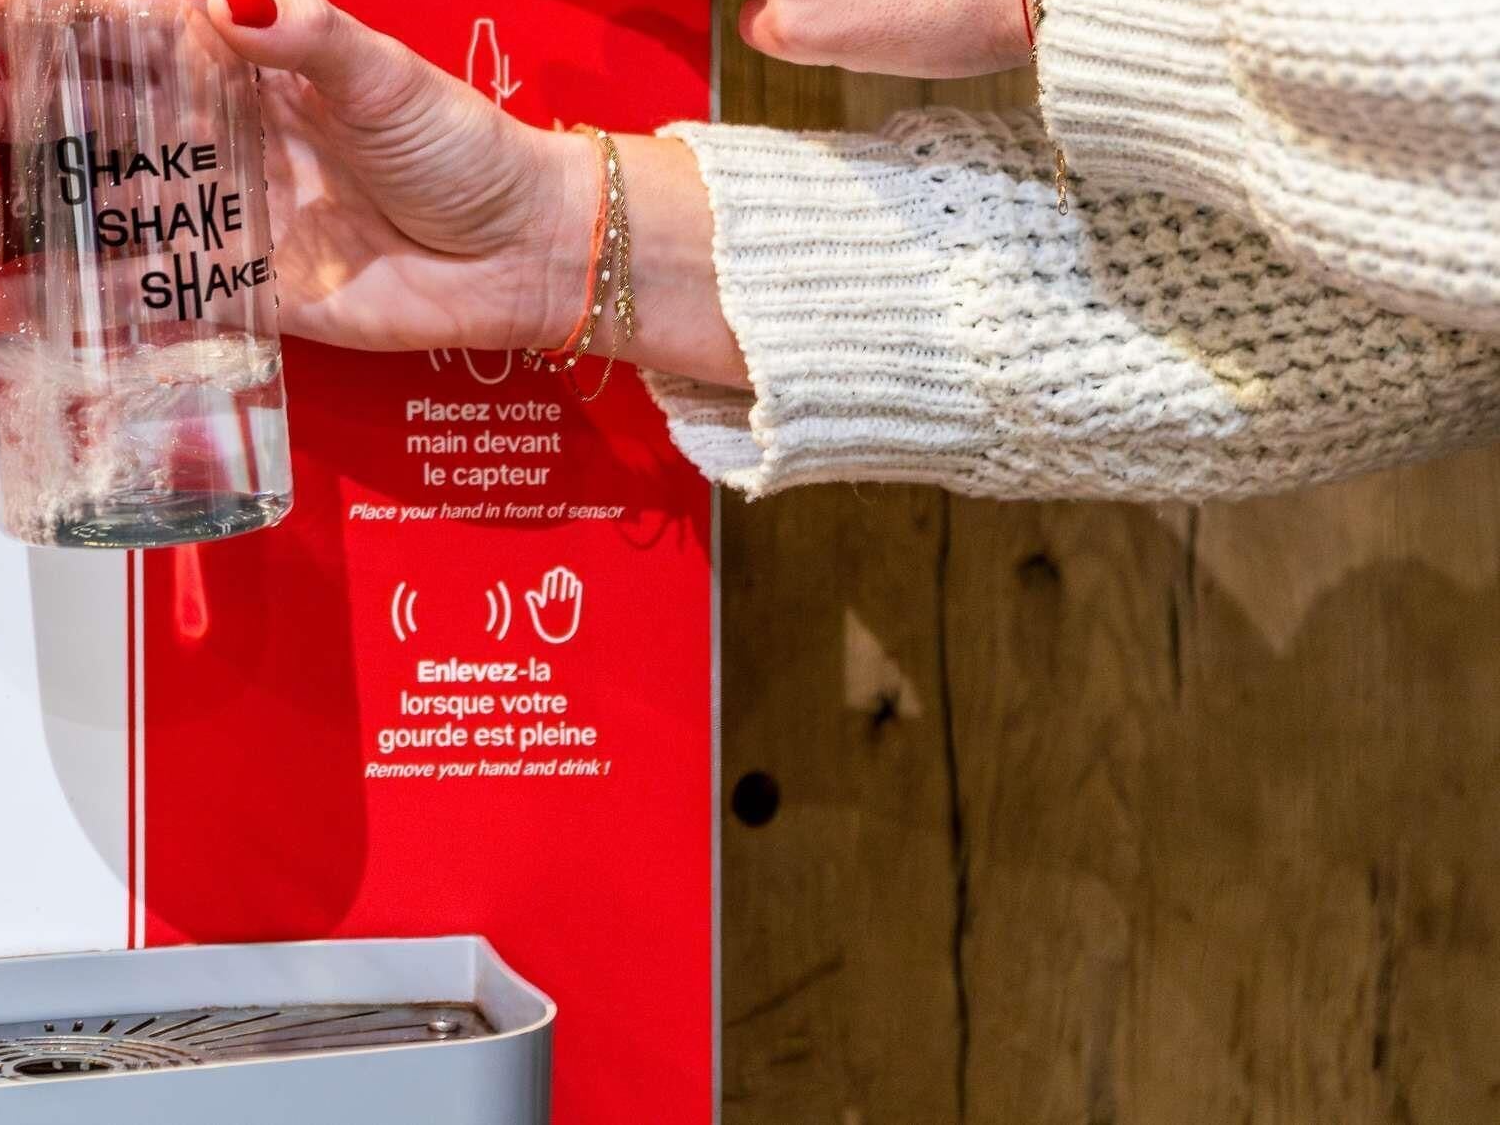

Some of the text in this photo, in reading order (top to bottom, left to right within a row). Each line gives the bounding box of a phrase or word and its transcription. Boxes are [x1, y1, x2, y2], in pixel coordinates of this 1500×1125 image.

[55, 130, 218, 207] SHAKE
[94, 181, 243, 252] SHAKE
[141, 250, 270, 321] SHAKE!
[406, 397, 562, 422] Placez votre
[406, 429, 562, 454] main devant
[423, 461, 550, 492] le capteur
[349, 502, 626, 524] Place your hand in front of sensor
[416, 656, 551, 683] Enlevez-la
[400, 690, 568, 721] lorsque votre
[377, 721, 598, 755] gourde est pleine
[365, 762, 436, 779] Remove
[437, 763, 477, 782] your
[477, 759, 523, 778] hand
[522, 759, 559, 777] and
[558, 758, 602, 777] drink
